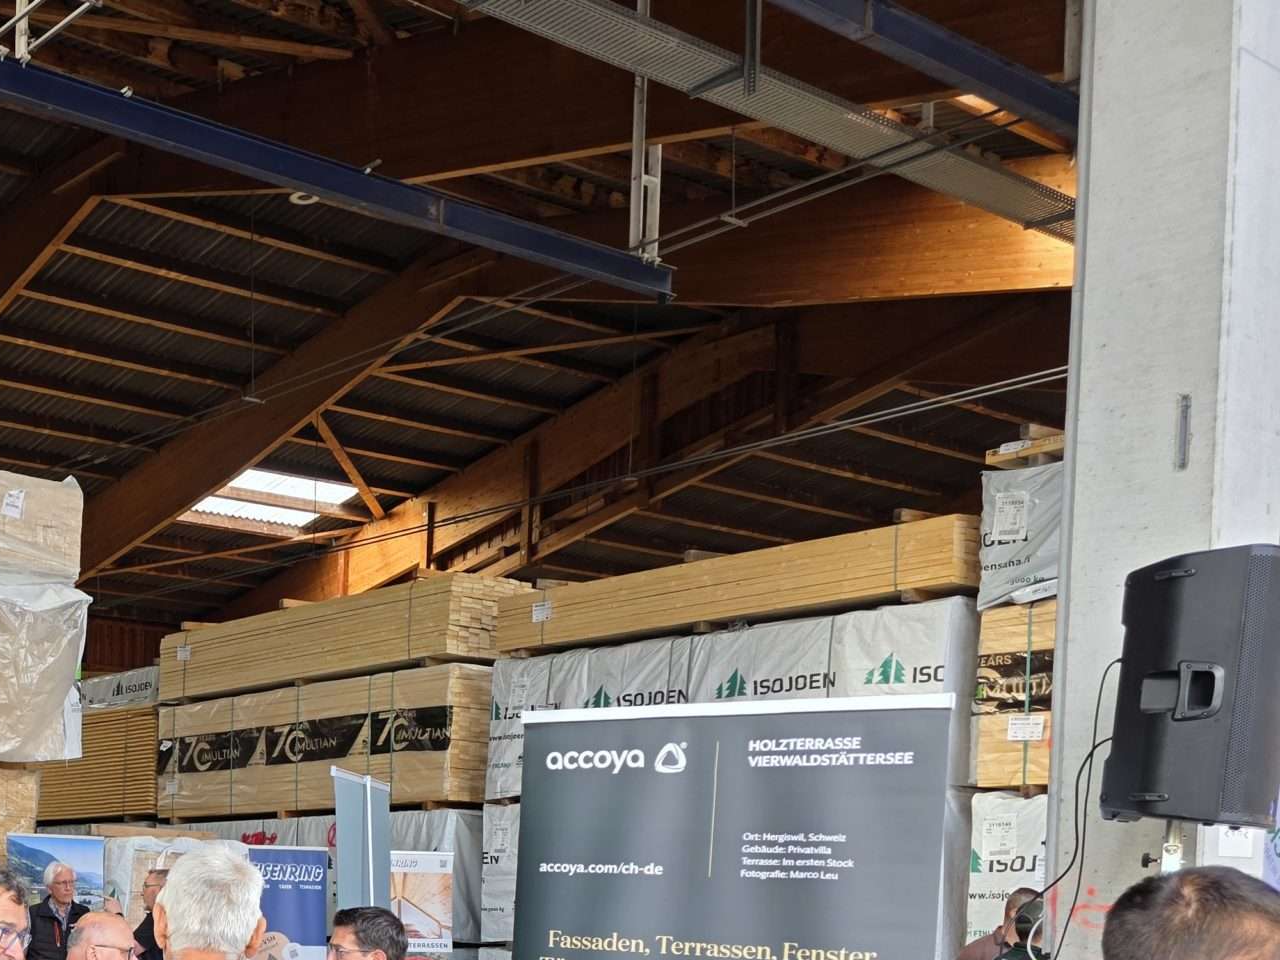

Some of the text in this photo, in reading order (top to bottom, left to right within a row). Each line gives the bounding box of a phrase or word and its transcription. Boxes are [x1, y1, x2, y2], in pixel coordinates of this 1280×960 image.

[753, 672, 836, 696] ISOJOEN
[616, 689, 689, 707] ISOJOEN
[748, 737, 862, 751] HOLZTERRASSE
[546, 748, 645, 774] accoya
[748, 751, 914, 767] VIERWALDSTÄTTERSEE
[742, 832, 761, 841] Ort:
[808, 832, 847, 842] Schweiz
[741, 845, 832, 855] Gebäude: Privatvilla
[539, 861, 664, 876] accoya.com/ch-de
[741, 857, 781, 866] Terrasse:
[796, 858, 825, 867] ersten
[826, 858, 855, 868] Stock
[740, 869, 839, 880] Fotografie: Marco Leu
[408, 941, 448, 949] TERRASSEN
[548, 929, 651, 956] Fassaden,
